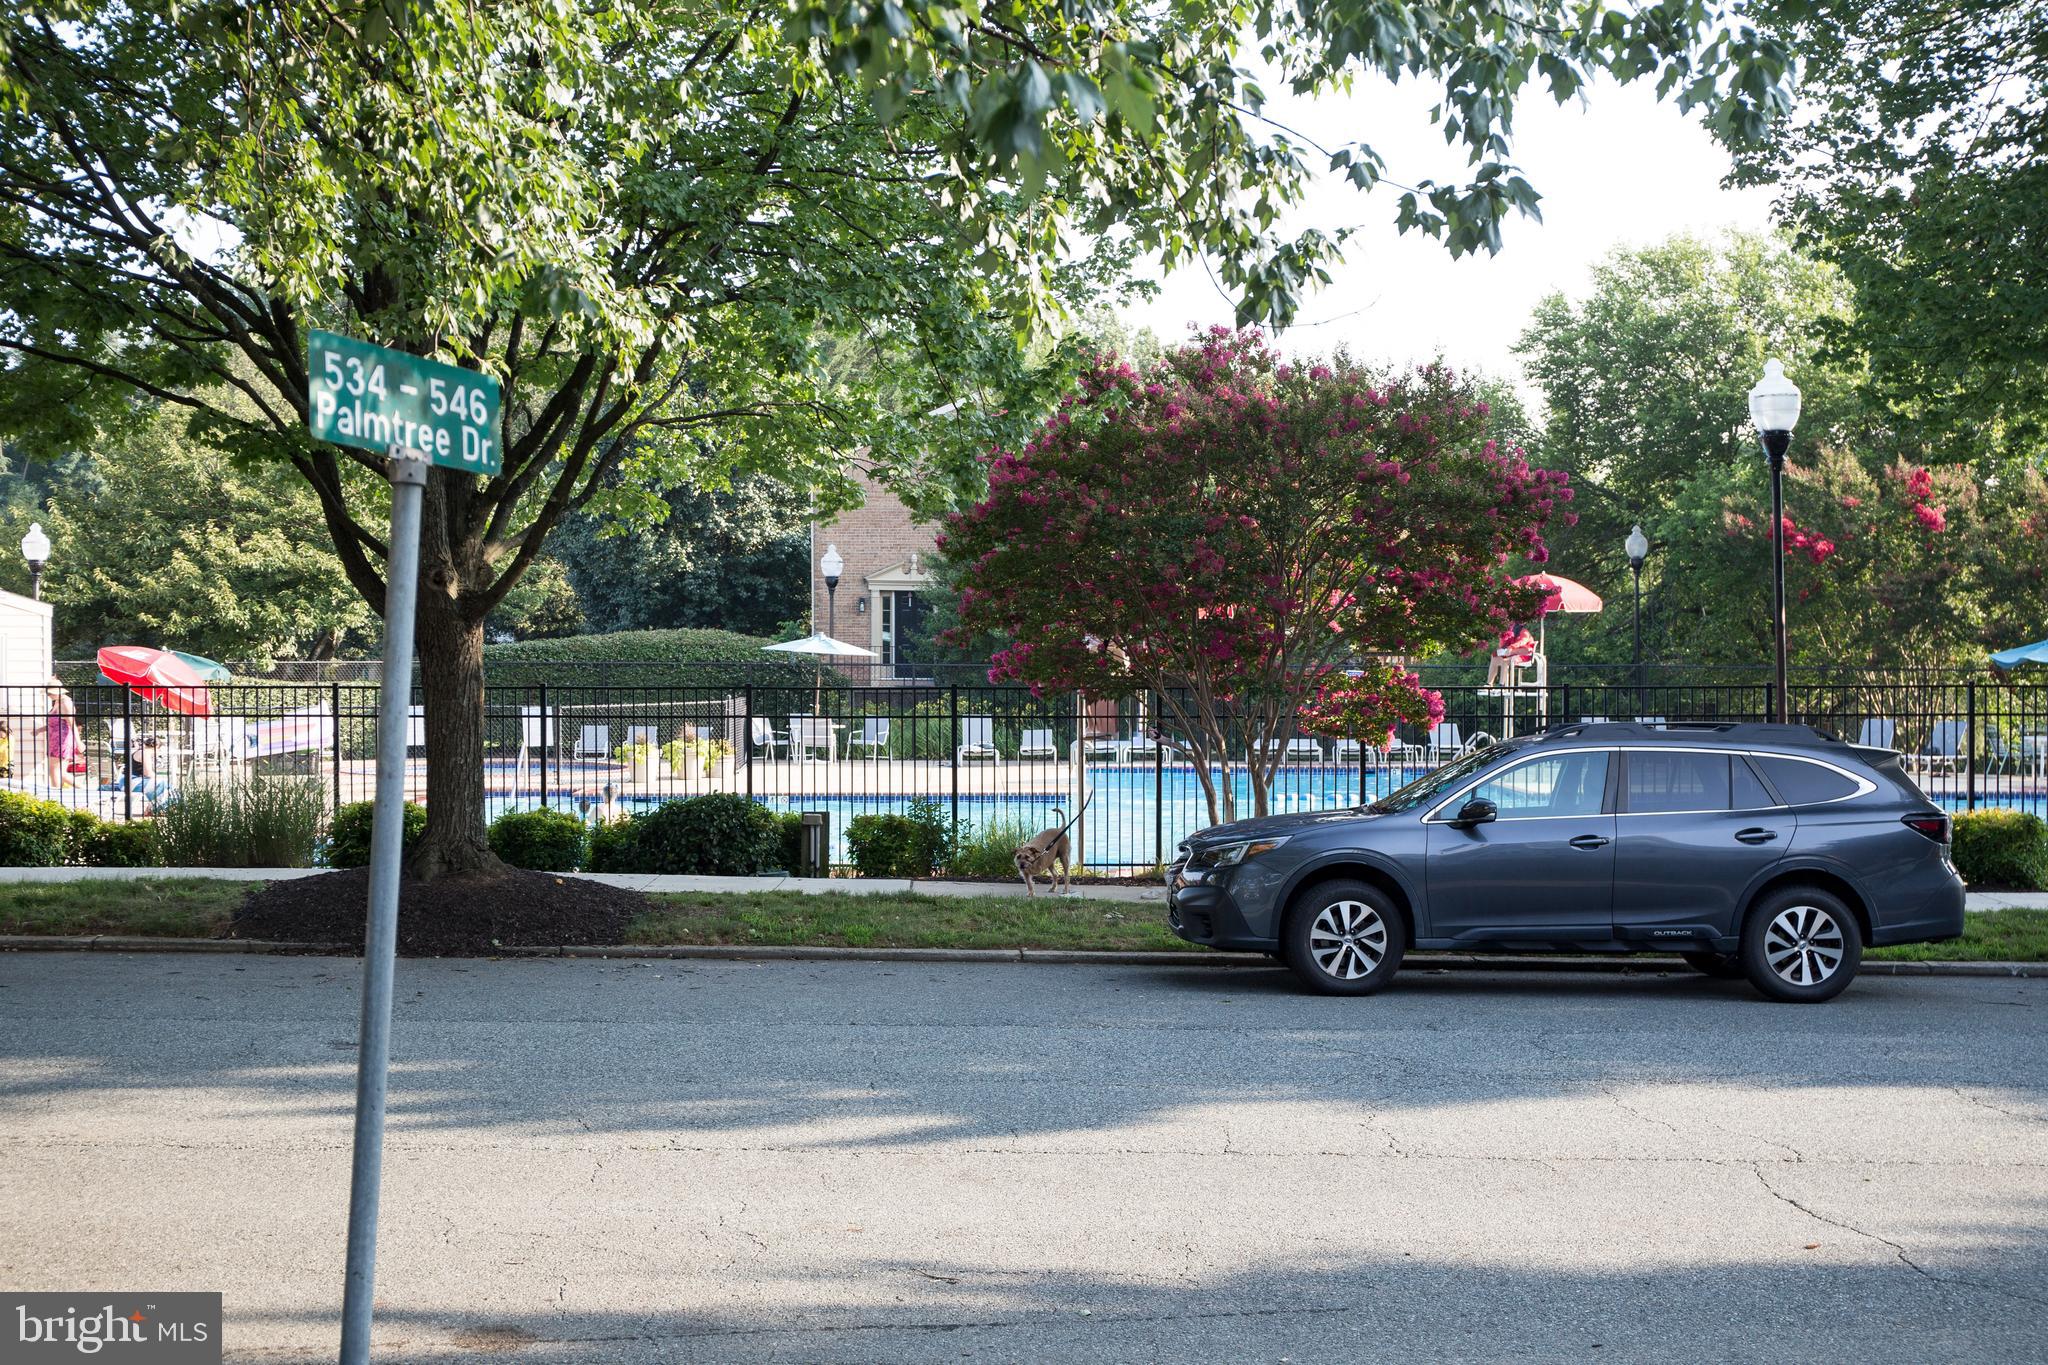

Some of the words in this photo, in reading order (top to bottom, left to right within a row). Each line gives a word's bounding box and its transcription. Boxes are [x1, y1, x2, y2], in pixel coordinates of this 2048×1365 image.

[324, 351, 388, 401] 534
[430, 377, 488, 426] 546
[316, 390, 450, 457] Palmtree
[462, 425, 496, 467] Dr.
